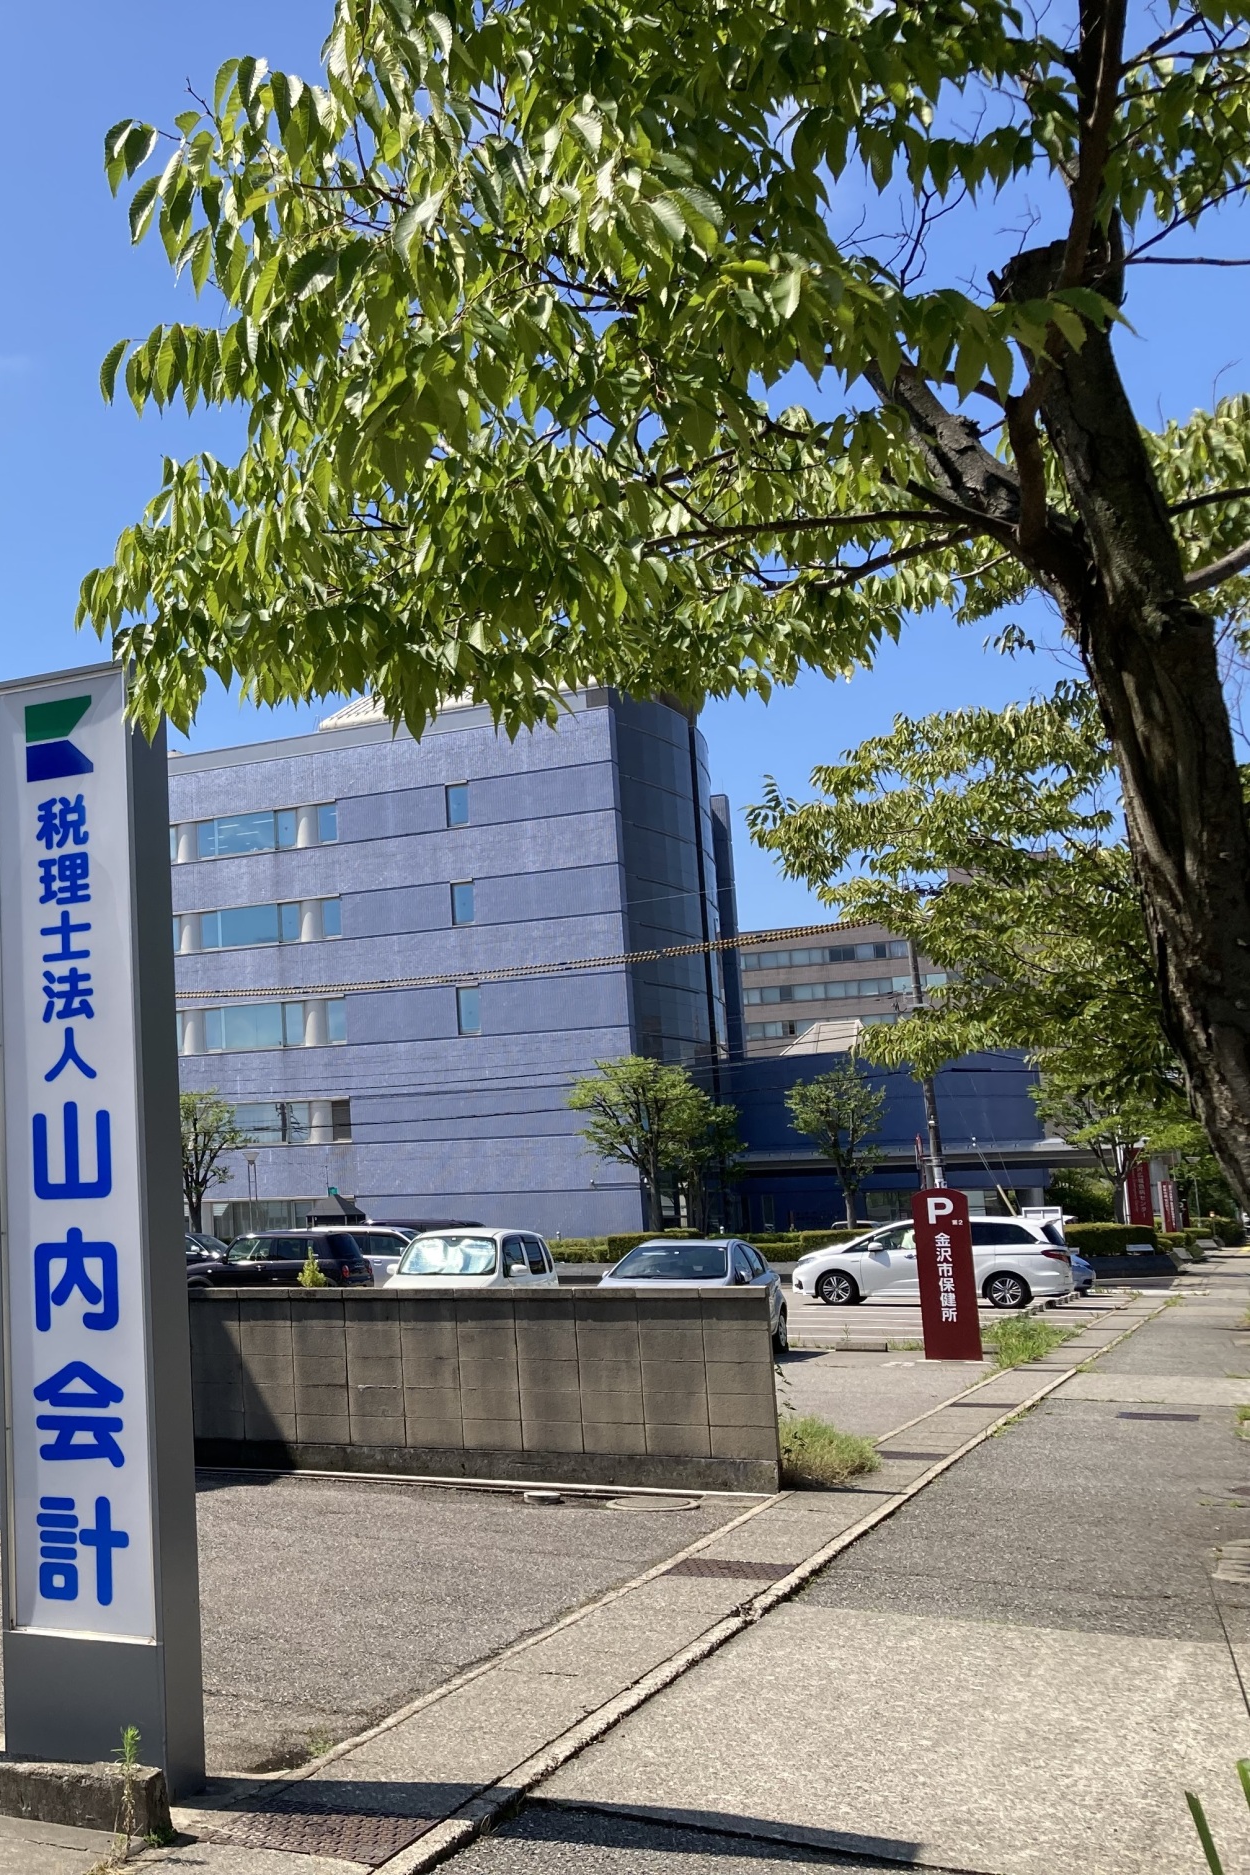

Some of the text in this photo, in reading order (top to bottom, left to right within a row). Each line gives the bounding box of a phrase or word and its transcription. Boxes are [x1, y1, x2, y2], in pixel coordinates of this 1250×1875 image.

[927, 1197, 954, 1225] P
[934, 1232, 958, 1322] 金沢市保健所
